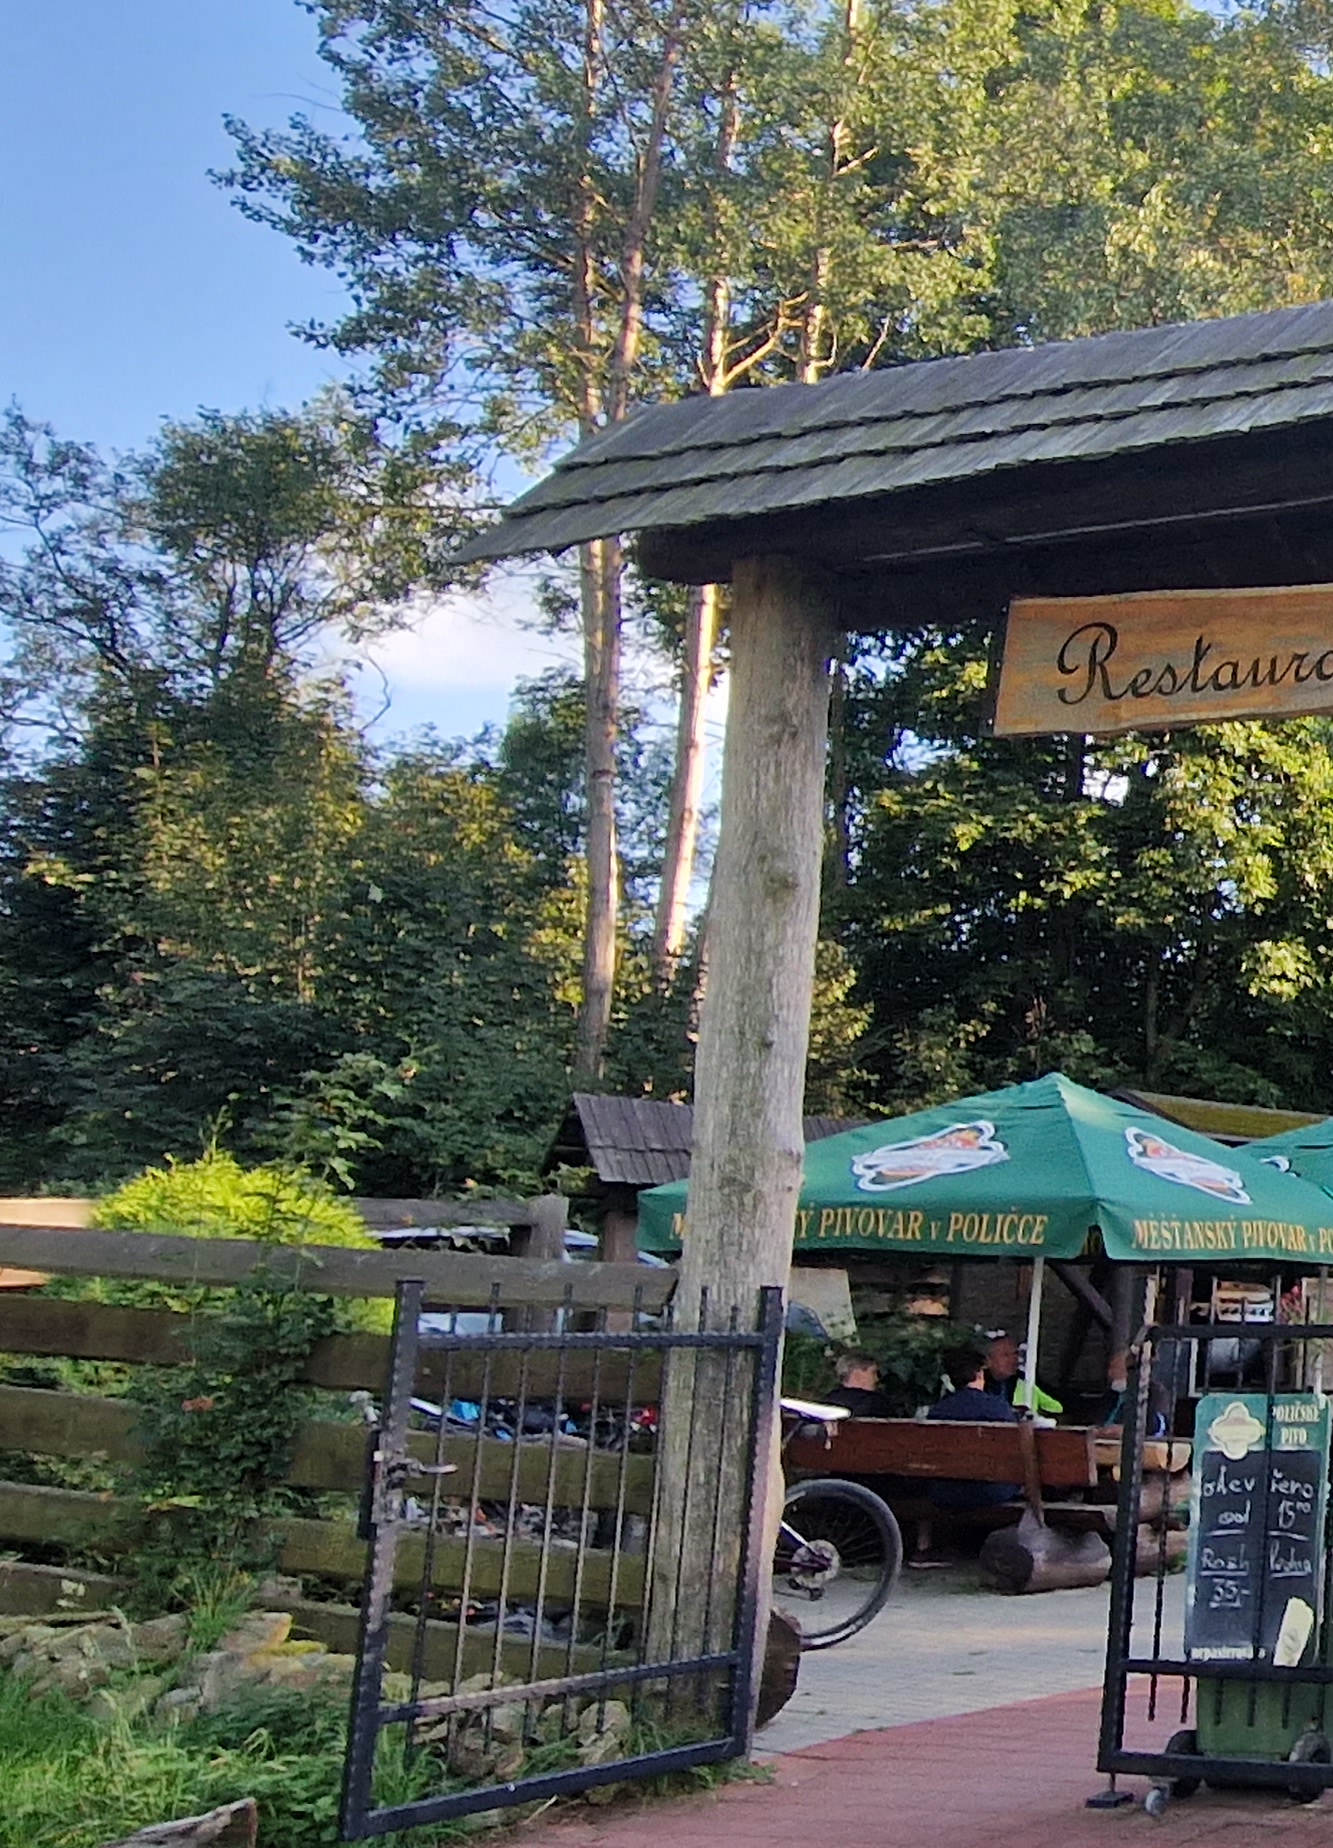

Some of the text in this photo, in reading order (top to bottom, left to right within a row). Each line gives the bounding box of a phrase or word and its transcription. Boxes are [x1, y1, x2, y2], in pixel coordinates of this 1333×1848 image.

[819, 1206, 923, 1241] PIVOVAR
[929, 1220, 942, 1241] v
[946, 1204, 1049, 1246] POLIČCE
[1242, 1219, 1308, 1252] PIVOVAR
[1280, 1426, 1308, 1445] PIVO
